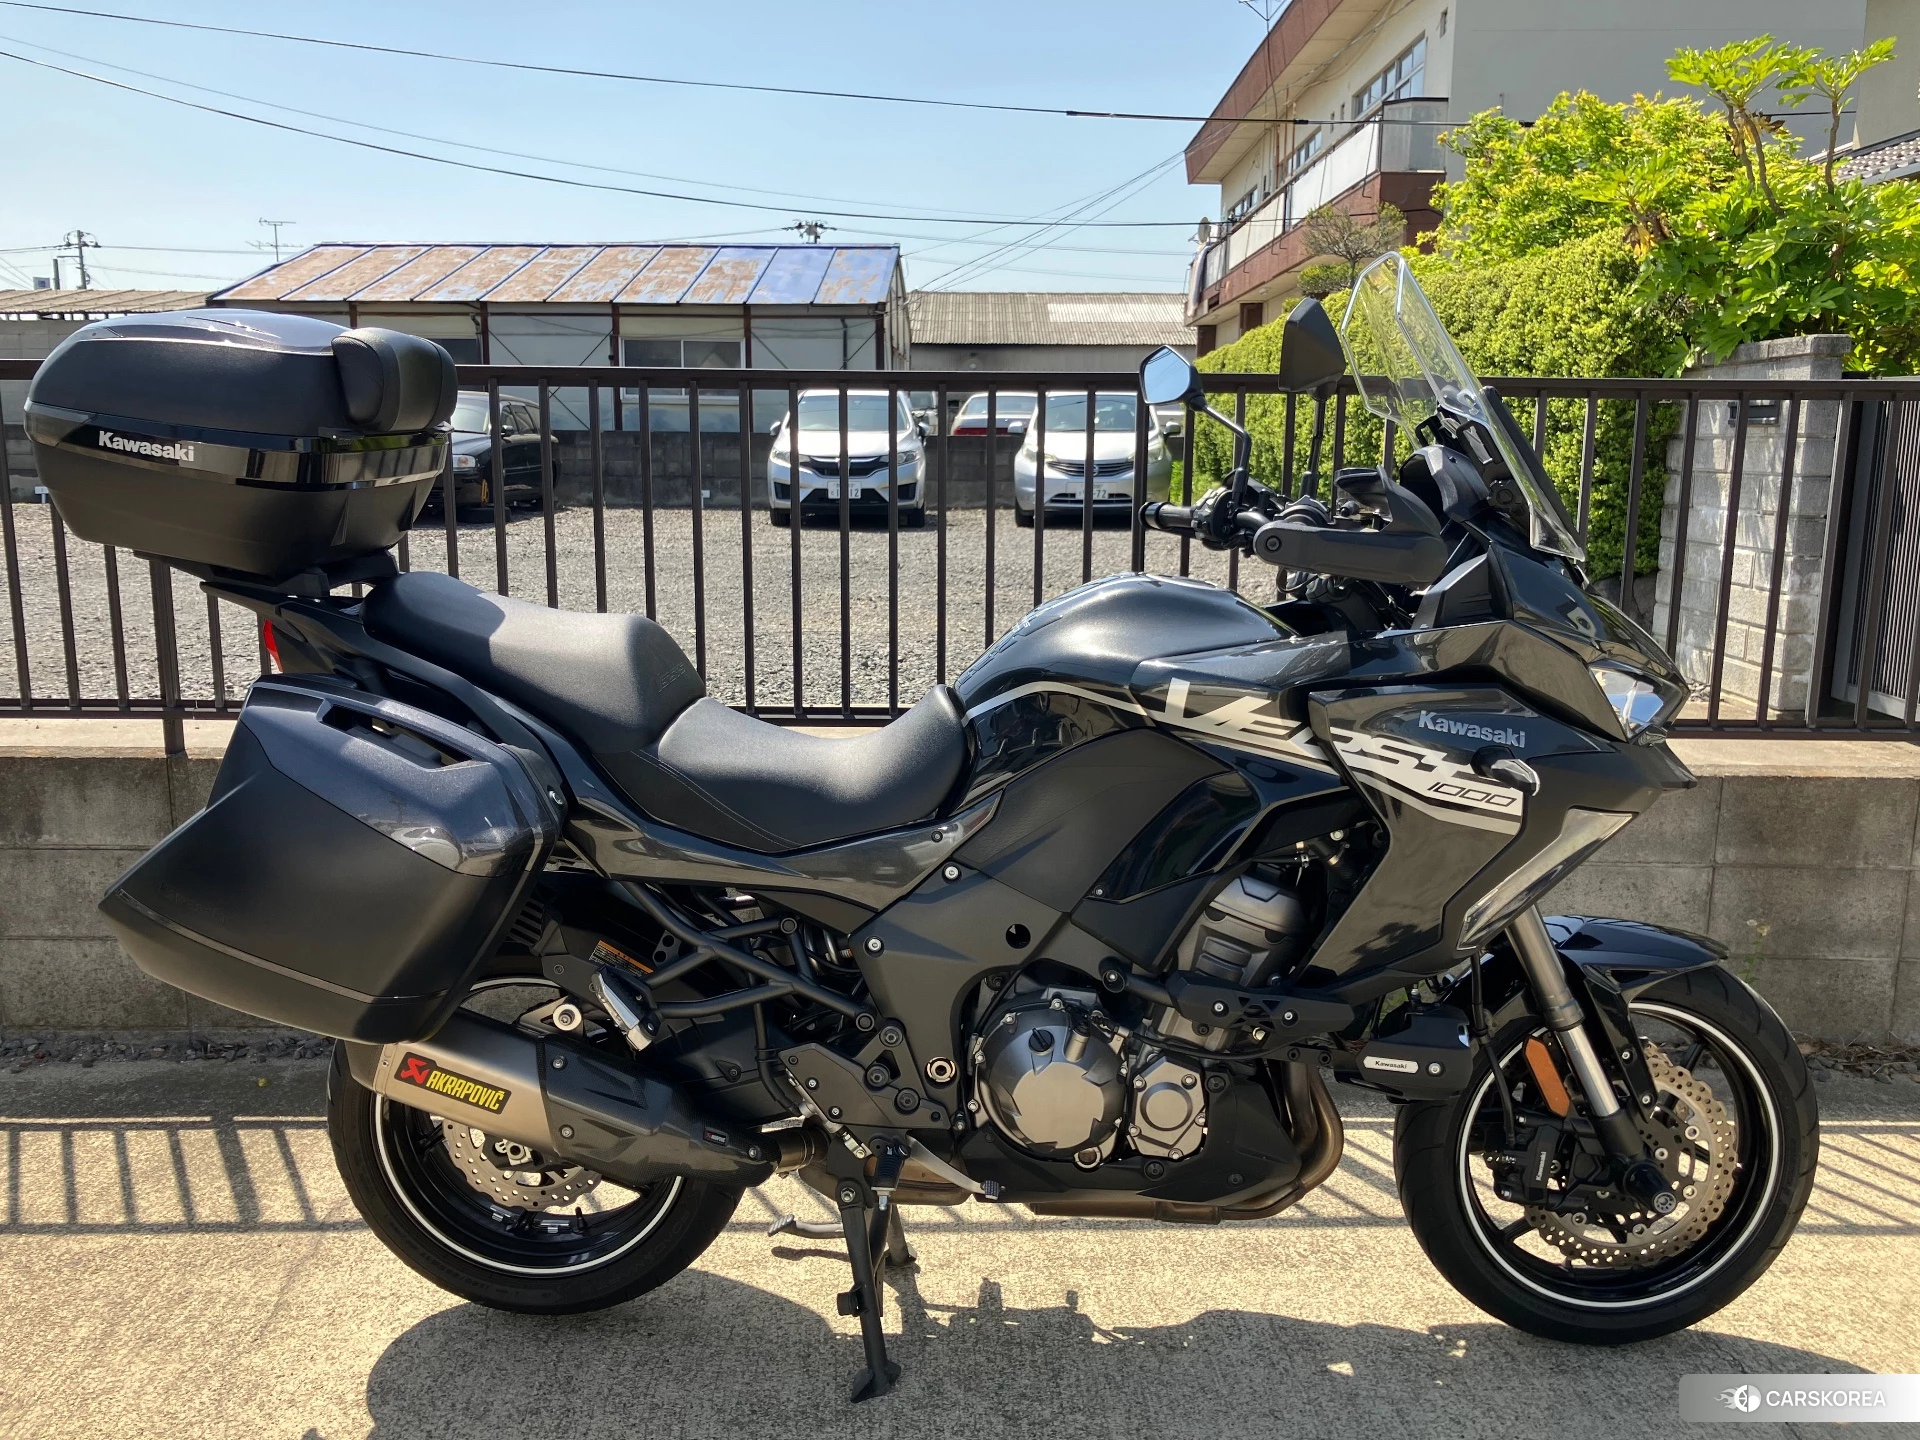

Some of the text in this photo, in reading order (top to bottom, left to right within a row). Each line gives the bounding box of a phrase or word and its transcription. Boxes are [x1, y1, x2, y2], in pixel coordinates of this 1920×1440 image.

[98, 430, 195, 462] Kawasaki
[1418, 709, 1526, 749] Kawasaki
[1426, 781, 1518, 808] 1000
[1374, 1060, 1408, 1069] Kawasaki
